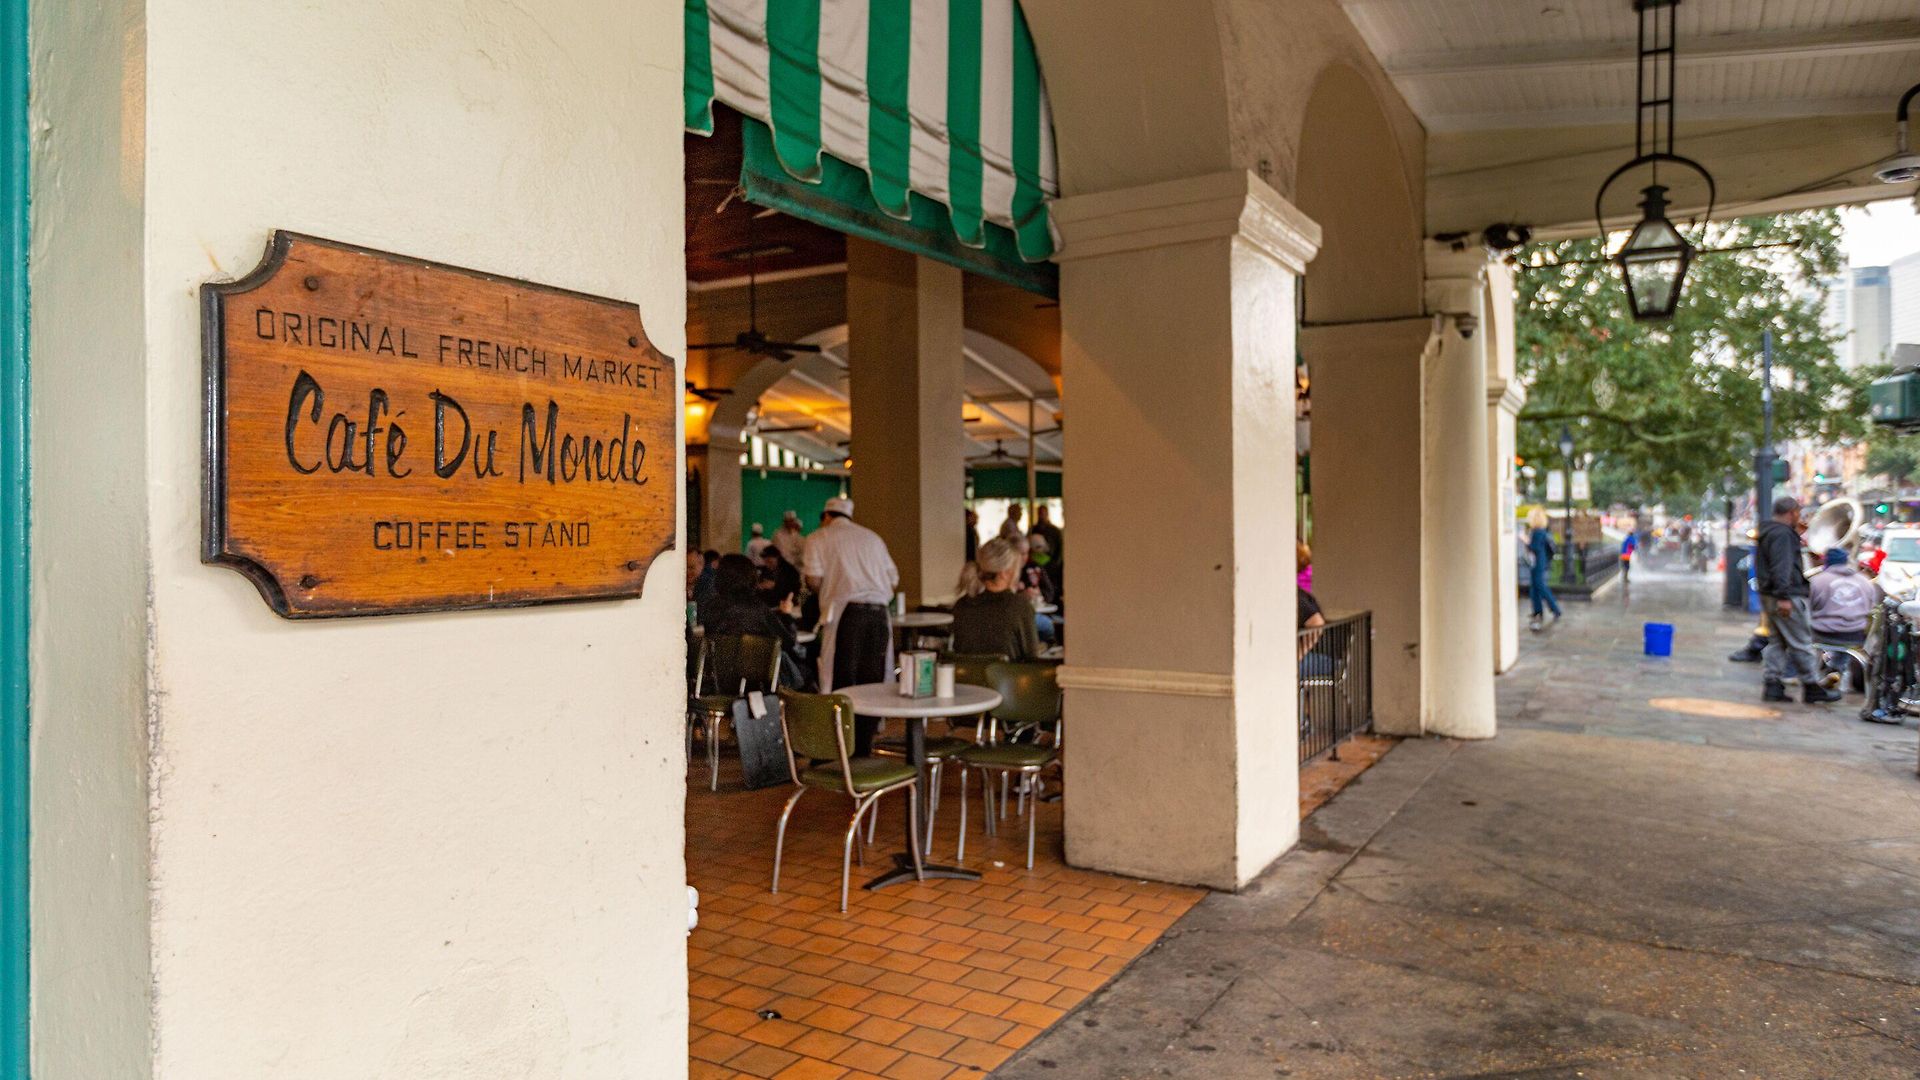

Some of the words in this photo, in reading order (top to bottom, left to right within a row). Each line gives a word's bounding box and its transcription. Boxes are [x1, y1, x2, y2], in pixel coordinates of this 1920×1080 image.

[256, 308, 419, 358] ORIGINAL
[439, 334, 546, 376] FRENCH
[563, 352, 662, 390] MARKET
[285, 369, 412, 479] Café
[428, 388, 503, 480] Du
[518, 399, 648, 486] Monde
[373, 520, 487, 550] COFFEE
[504, 521, 591, 548] STAND
